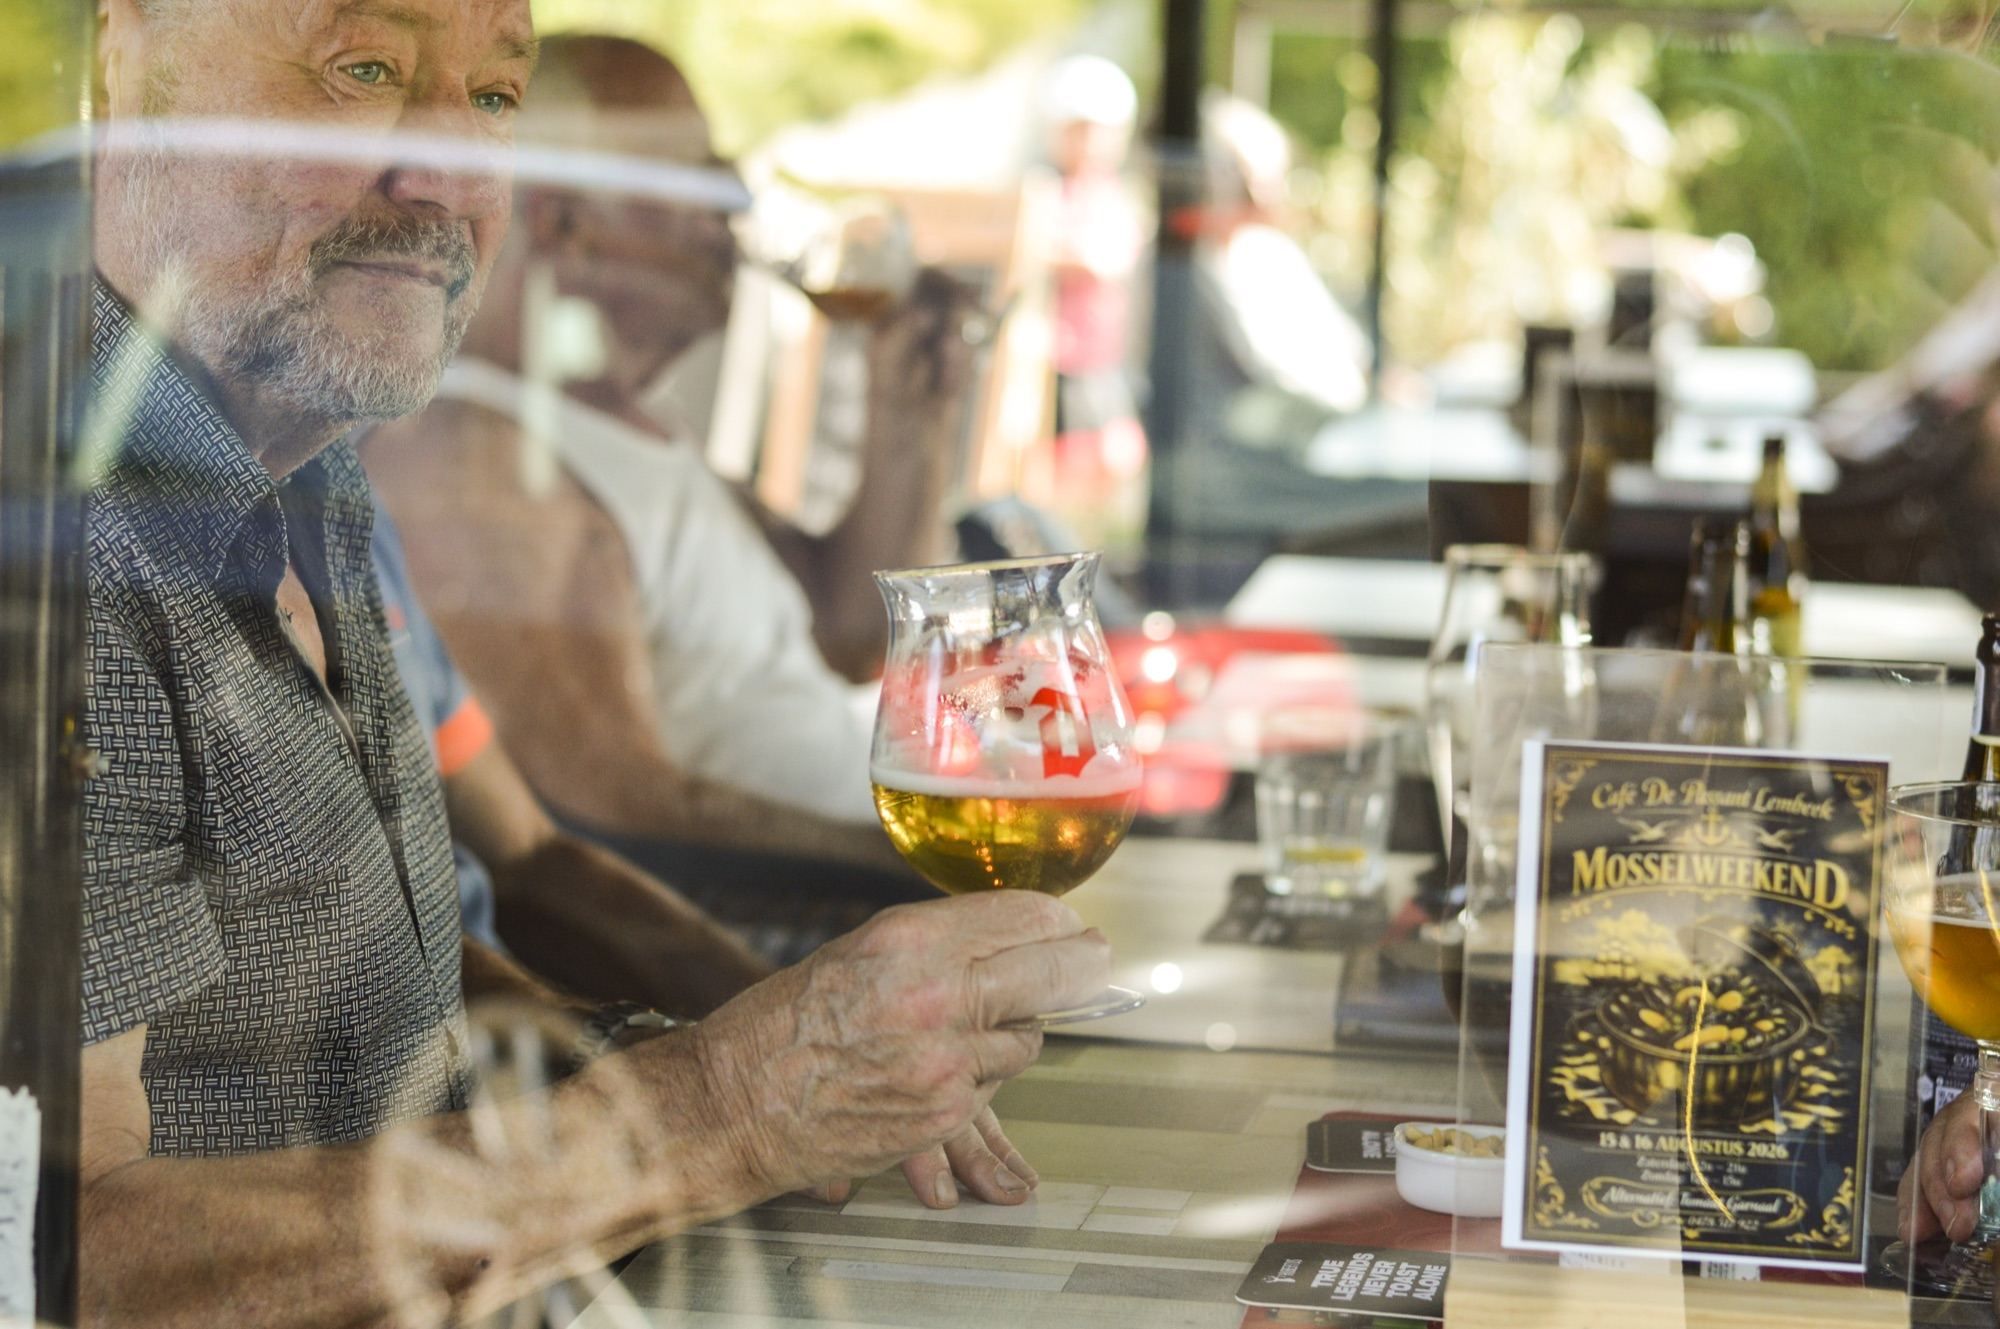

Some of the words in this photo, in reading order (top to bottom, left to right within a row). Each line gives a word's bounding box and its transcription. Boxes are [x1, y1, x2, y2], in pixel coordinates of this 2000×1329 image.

[1641, 777, 1677, 806] De
[1619, 1134, 1631, 1149] &
[1656, 1136, 1744, 1155] AUGUSTUS
[1311, 1259, 1345, 1288] TRUE
[1331, 1252, 1375, 1301] LEGENDS
[1360, 1260, 1397, 1297] NEVER
[1385, 1262, 1421, 1298] TOAST
[1412, 1264, 1447, 1301] ALONE
